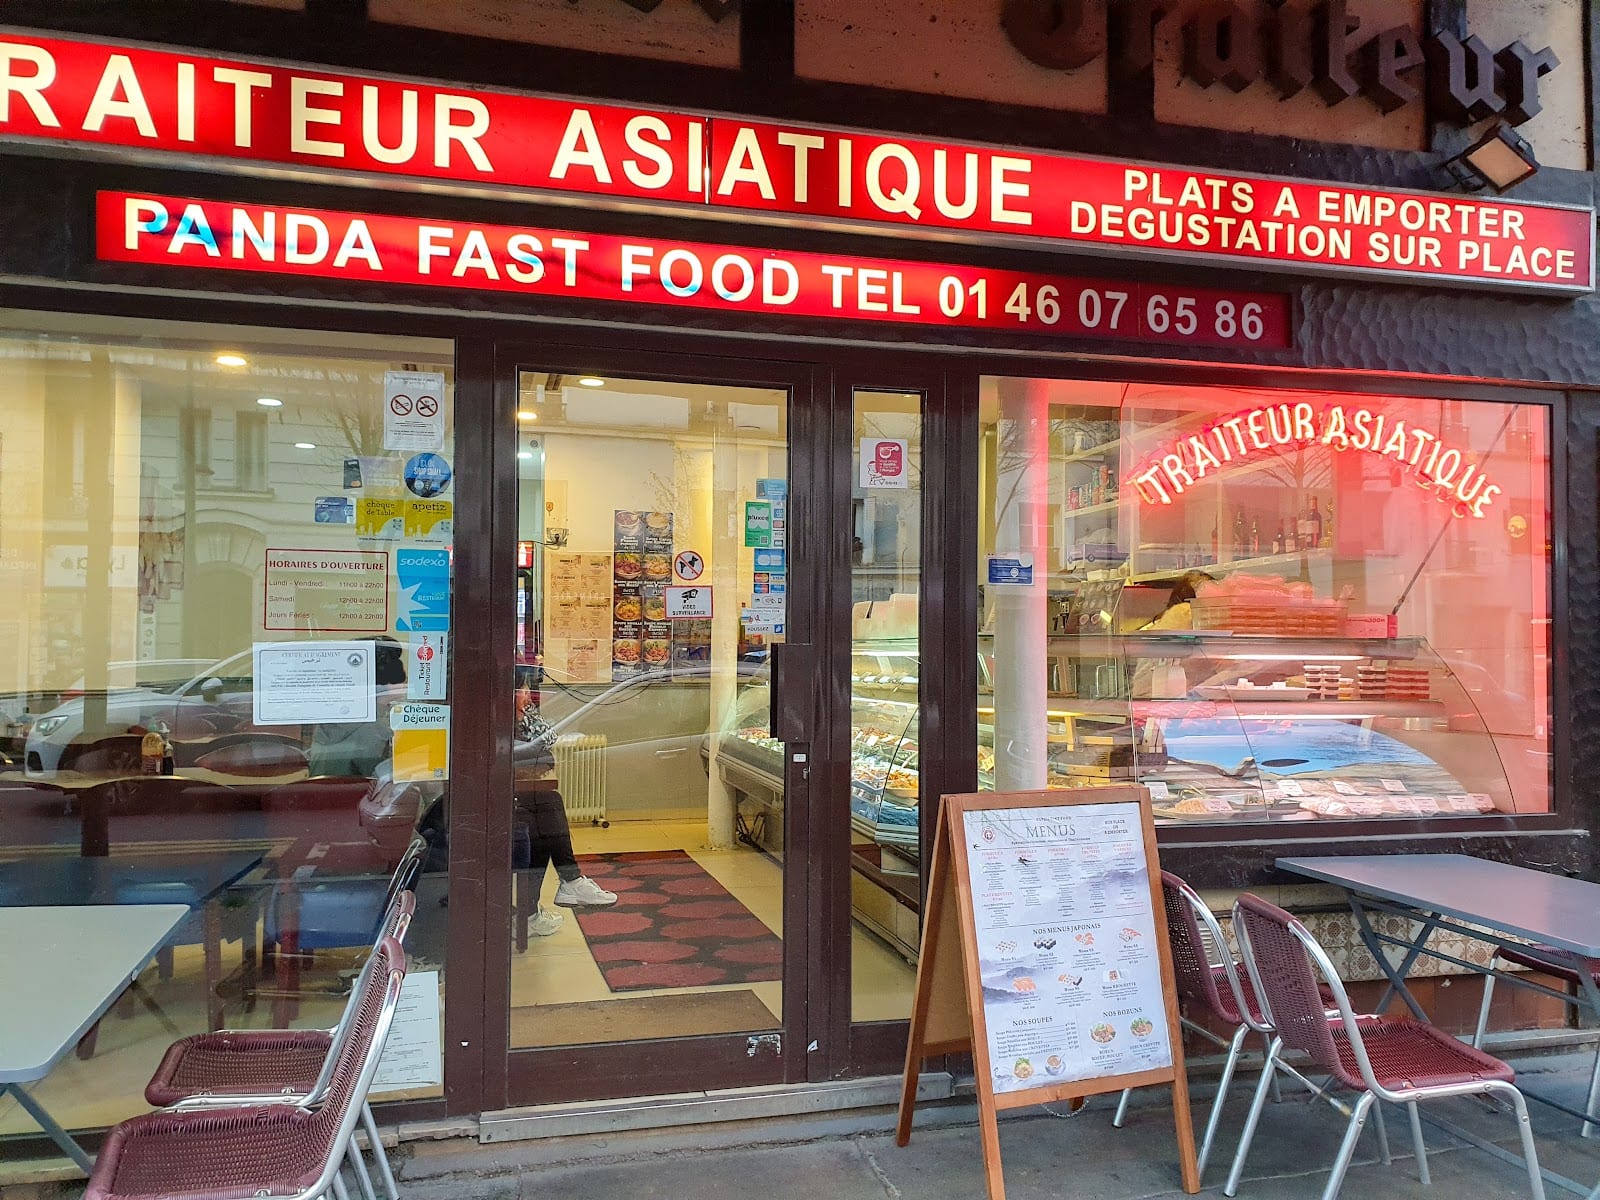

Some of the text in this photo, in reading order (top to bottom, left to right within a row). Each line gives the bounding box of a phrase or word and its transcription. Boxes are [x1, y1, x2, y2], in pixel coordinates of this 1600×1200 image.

[0, 42, 1033, 227] RAITEUR ASIATIQUE
[1124, 169, 1525, 241] PLATS A EMPORTER
[1070, 201, 1576, 281] DEGUSTATION SUR PLACE
[123, 197, 1265, 341] PANDA FAST FOOD TEL 01 46 07 65 86
[1136, 402, 1502, 519] TRAITEUR ASIATIQUE
[411, 502, 447, 513] apetiz
[269, 560, 385, 571] HORAIRES D'OUVERTURE
[399, 556, 446, 568] sodexo
[269, 579, 288, 587] Lundi
[269, 595, 295, 603] Samedi
[268, 611, 288, 619] Jours
[403, 704, 440, 715] Chèque
[403, 714, 446, 725] Déjeuner
[1026, 823, 1076, 839] MENUS
[1032, 922, 1102, 936] NOS MENUS JAPONAIS
[1012, 1016, 1053, 1026] NOS SOUPES
